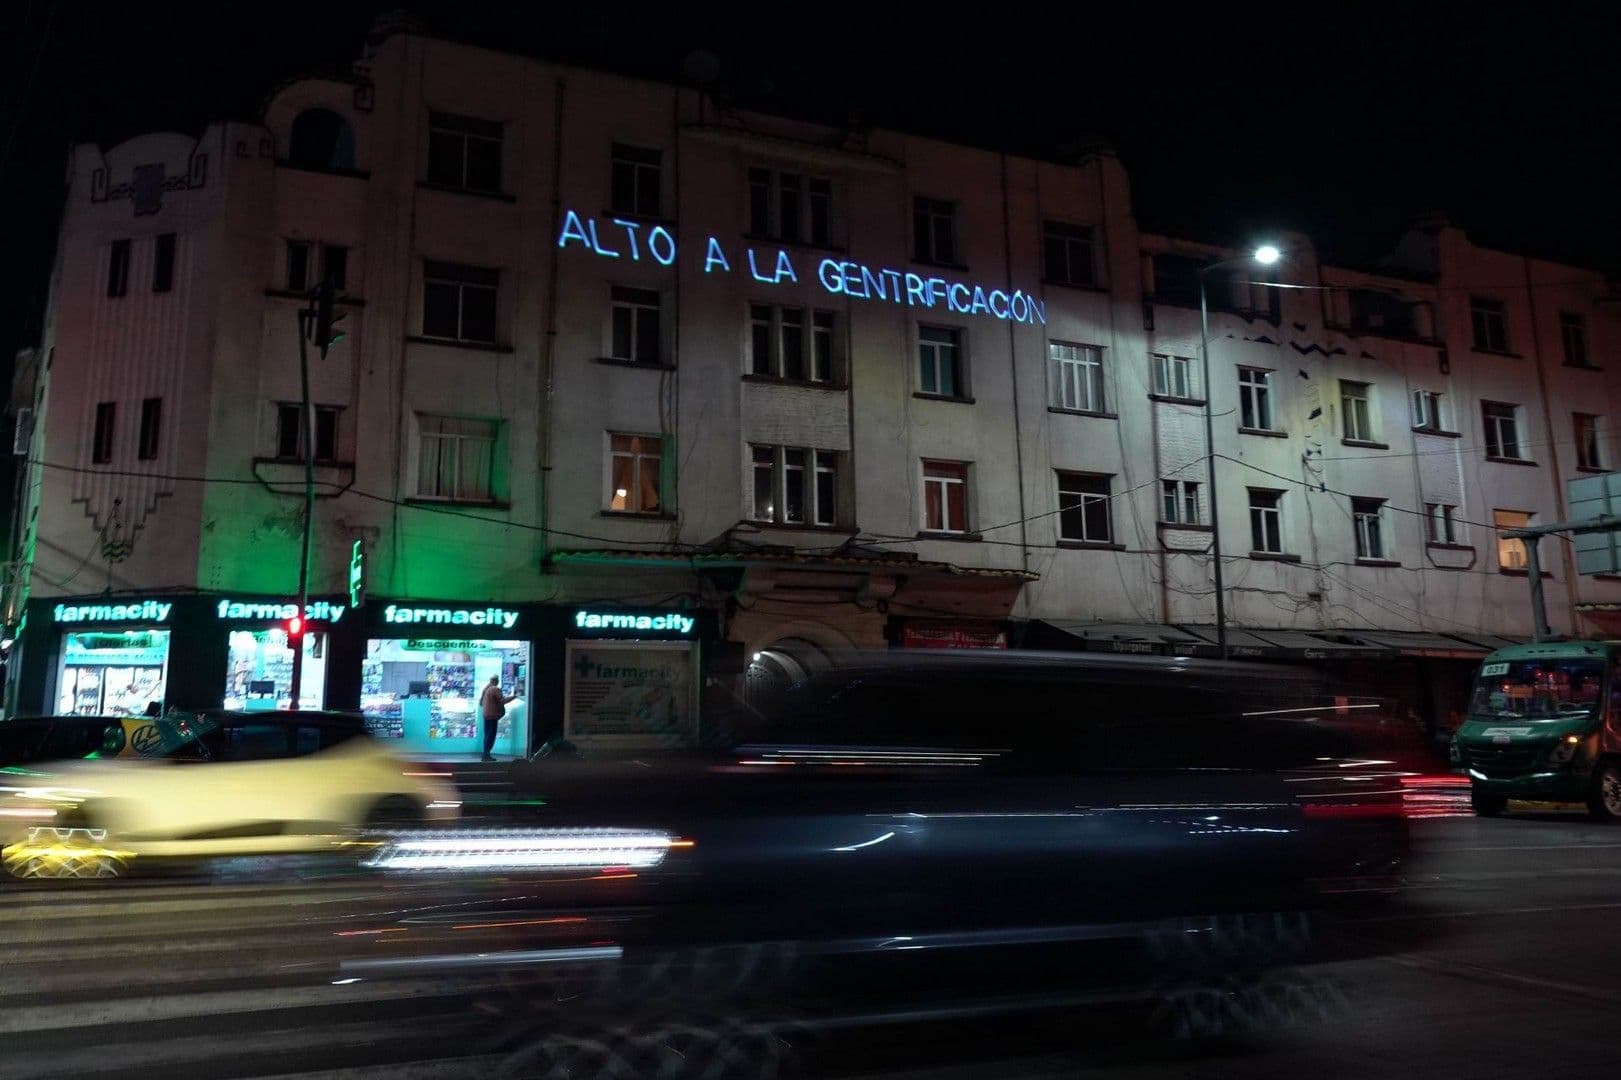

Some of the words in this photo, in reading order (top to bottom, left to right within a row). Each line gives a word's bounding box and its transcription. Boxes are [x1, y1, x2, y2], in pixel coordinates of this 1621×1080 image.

[558, 209, 676, 266] ALTO
[703, 236, 731, 273] A
[747, 248, 799, 284] LA
[53, 600, 172, 622] farmacity
[384, 604, 519, 629] farmacity
[575, 610, 694, 633] farmacity
[406, 638, 487, 649] Descuentos
